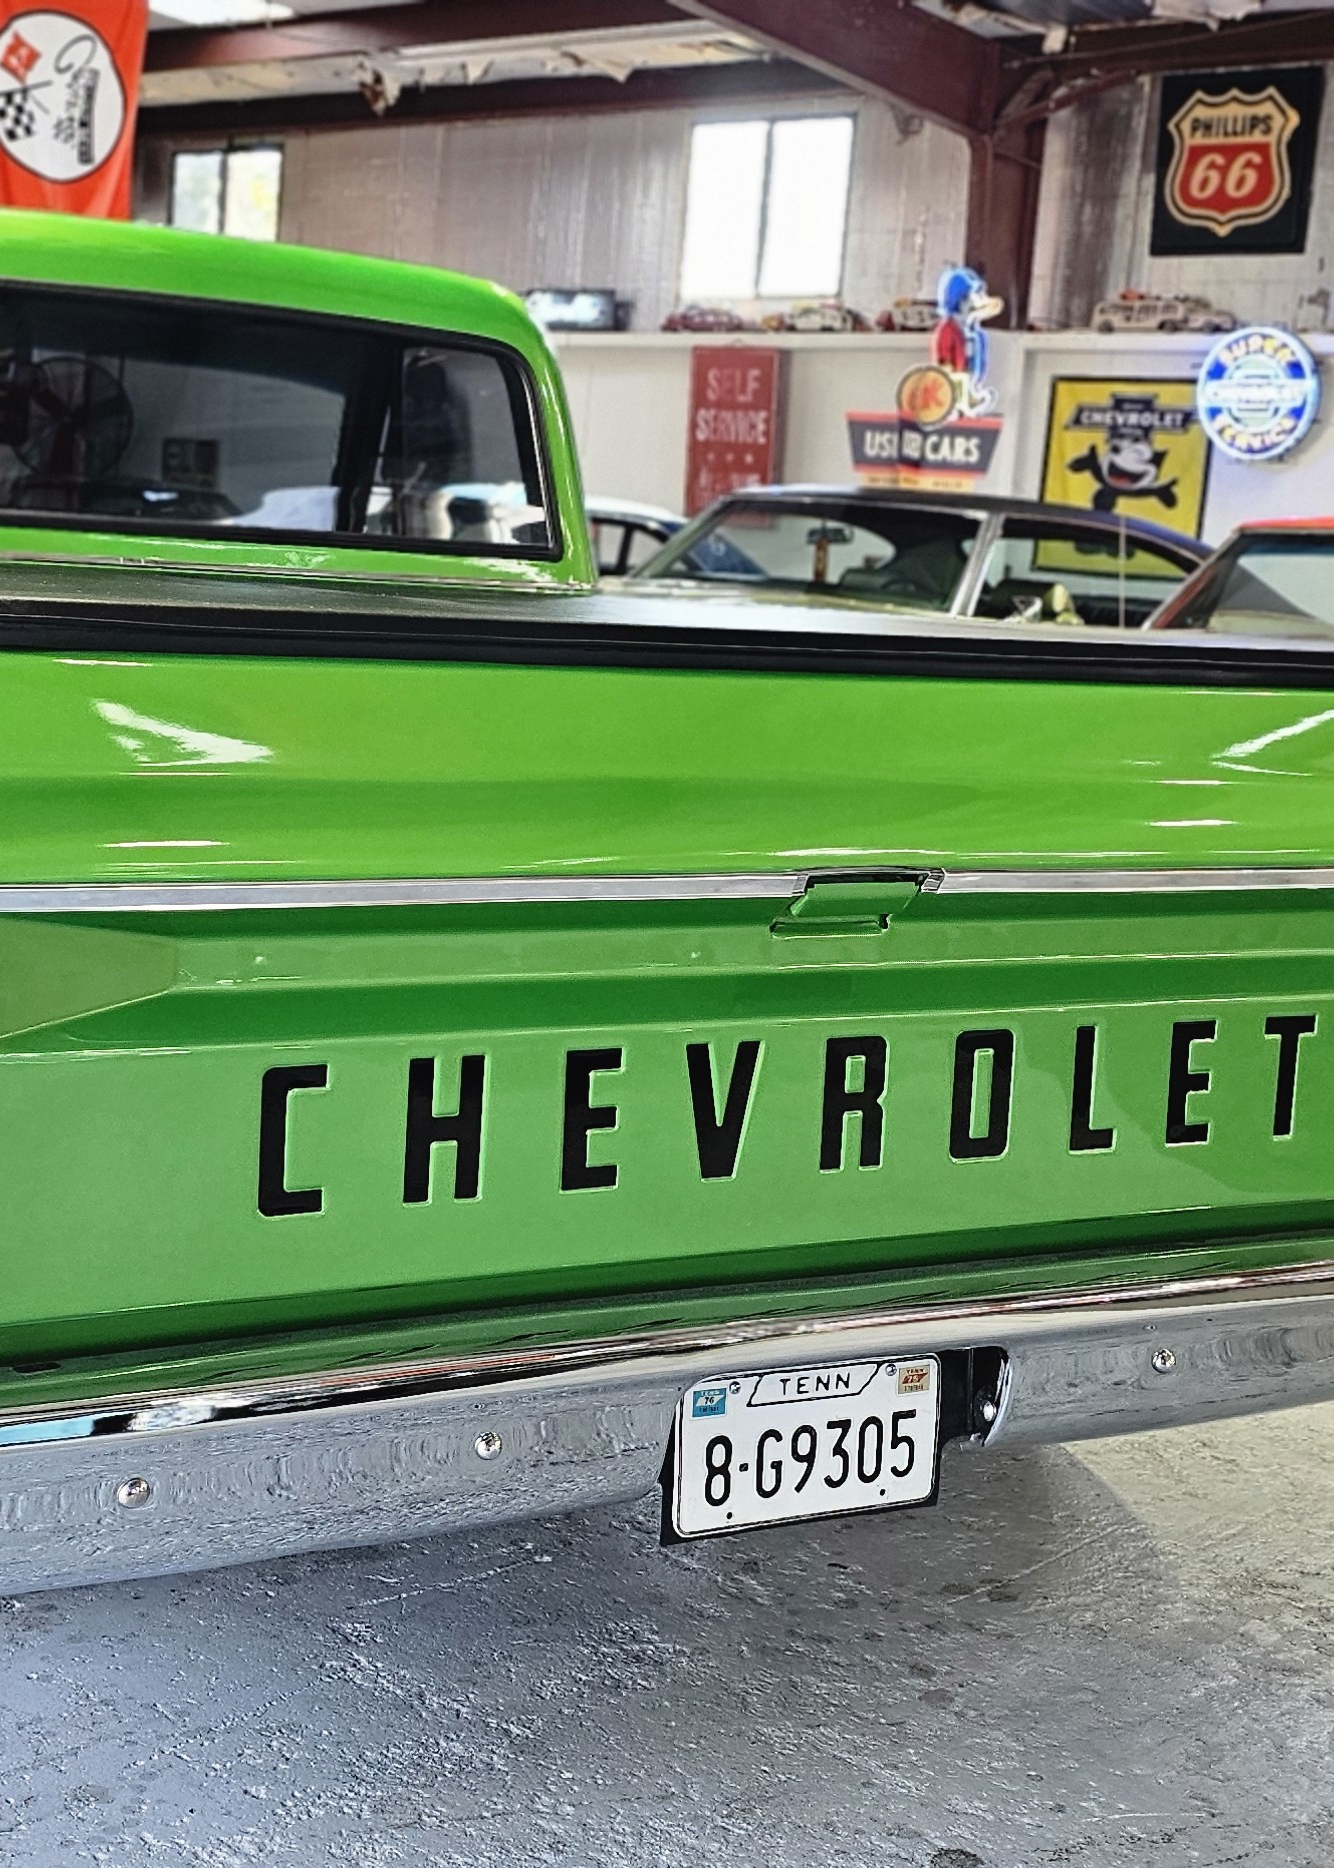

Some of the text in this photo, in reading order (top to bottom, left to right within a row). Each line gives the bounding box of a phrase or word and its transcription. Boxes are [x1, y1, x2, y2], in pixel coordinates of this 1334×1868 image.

[1190, 114, 1273, 138] PHILLIPS
[1188, 151, 1263, 199] 66
[1218, 334, 1297, 364] SUPER
[706, 367, 762, 401] SELF
[695, 408, 768, 444] SERVICE
[1079, 409, 1185, 428] CHEVROLET
[1213, 415, 1297, 451] SERVICE
[924, 434, 981, 463] CARS
[257, 1014, 1318, 1218] CHEVROLET
[779, 1372, 851, 1396] TENN
[705, 1397, 714, 1405] 76
